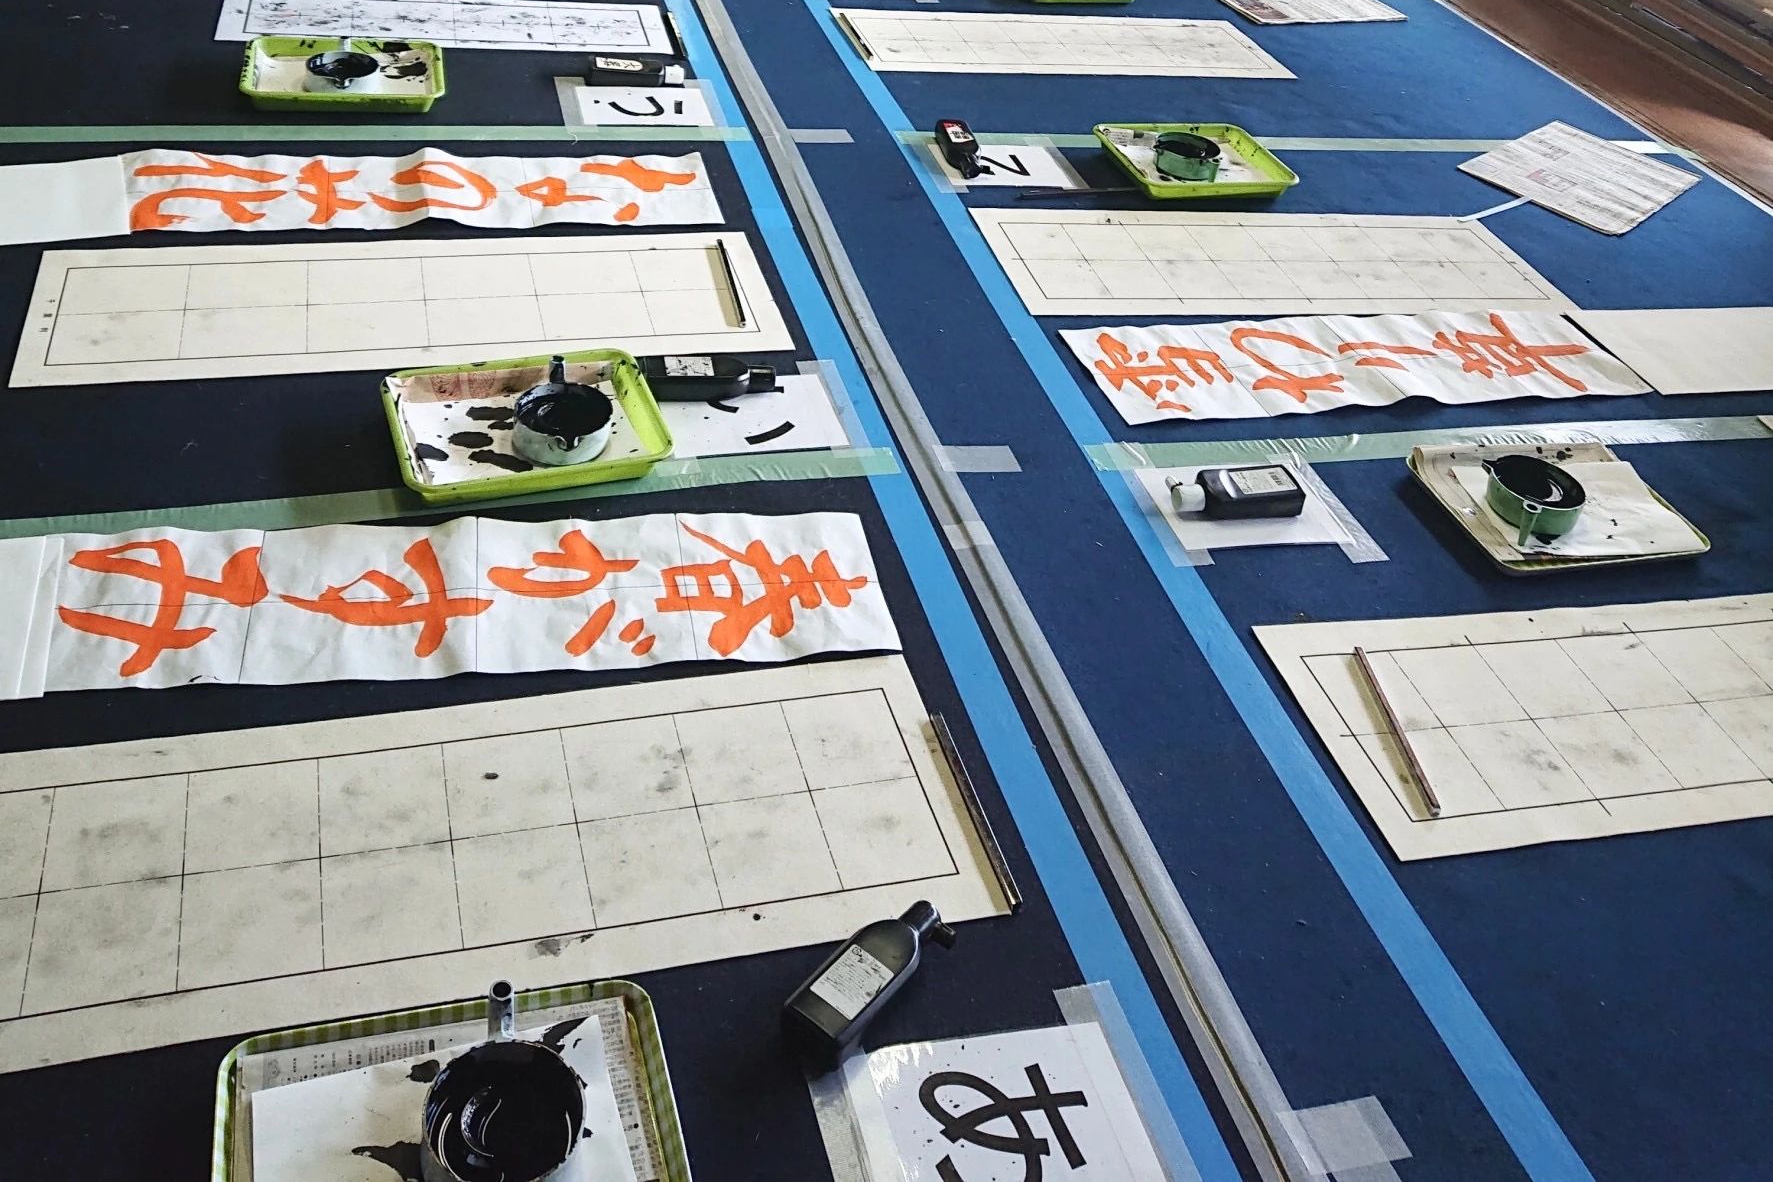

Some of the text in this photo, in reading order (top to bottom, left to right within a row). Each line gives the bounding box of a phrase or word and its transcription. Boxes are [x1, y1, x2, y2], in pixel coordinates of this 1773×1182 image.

[130, 151, 697, 231] なの花
[1095, 312, 1591, 413] 雪わり草
[57, 519, 868, 678] 春がすみ
